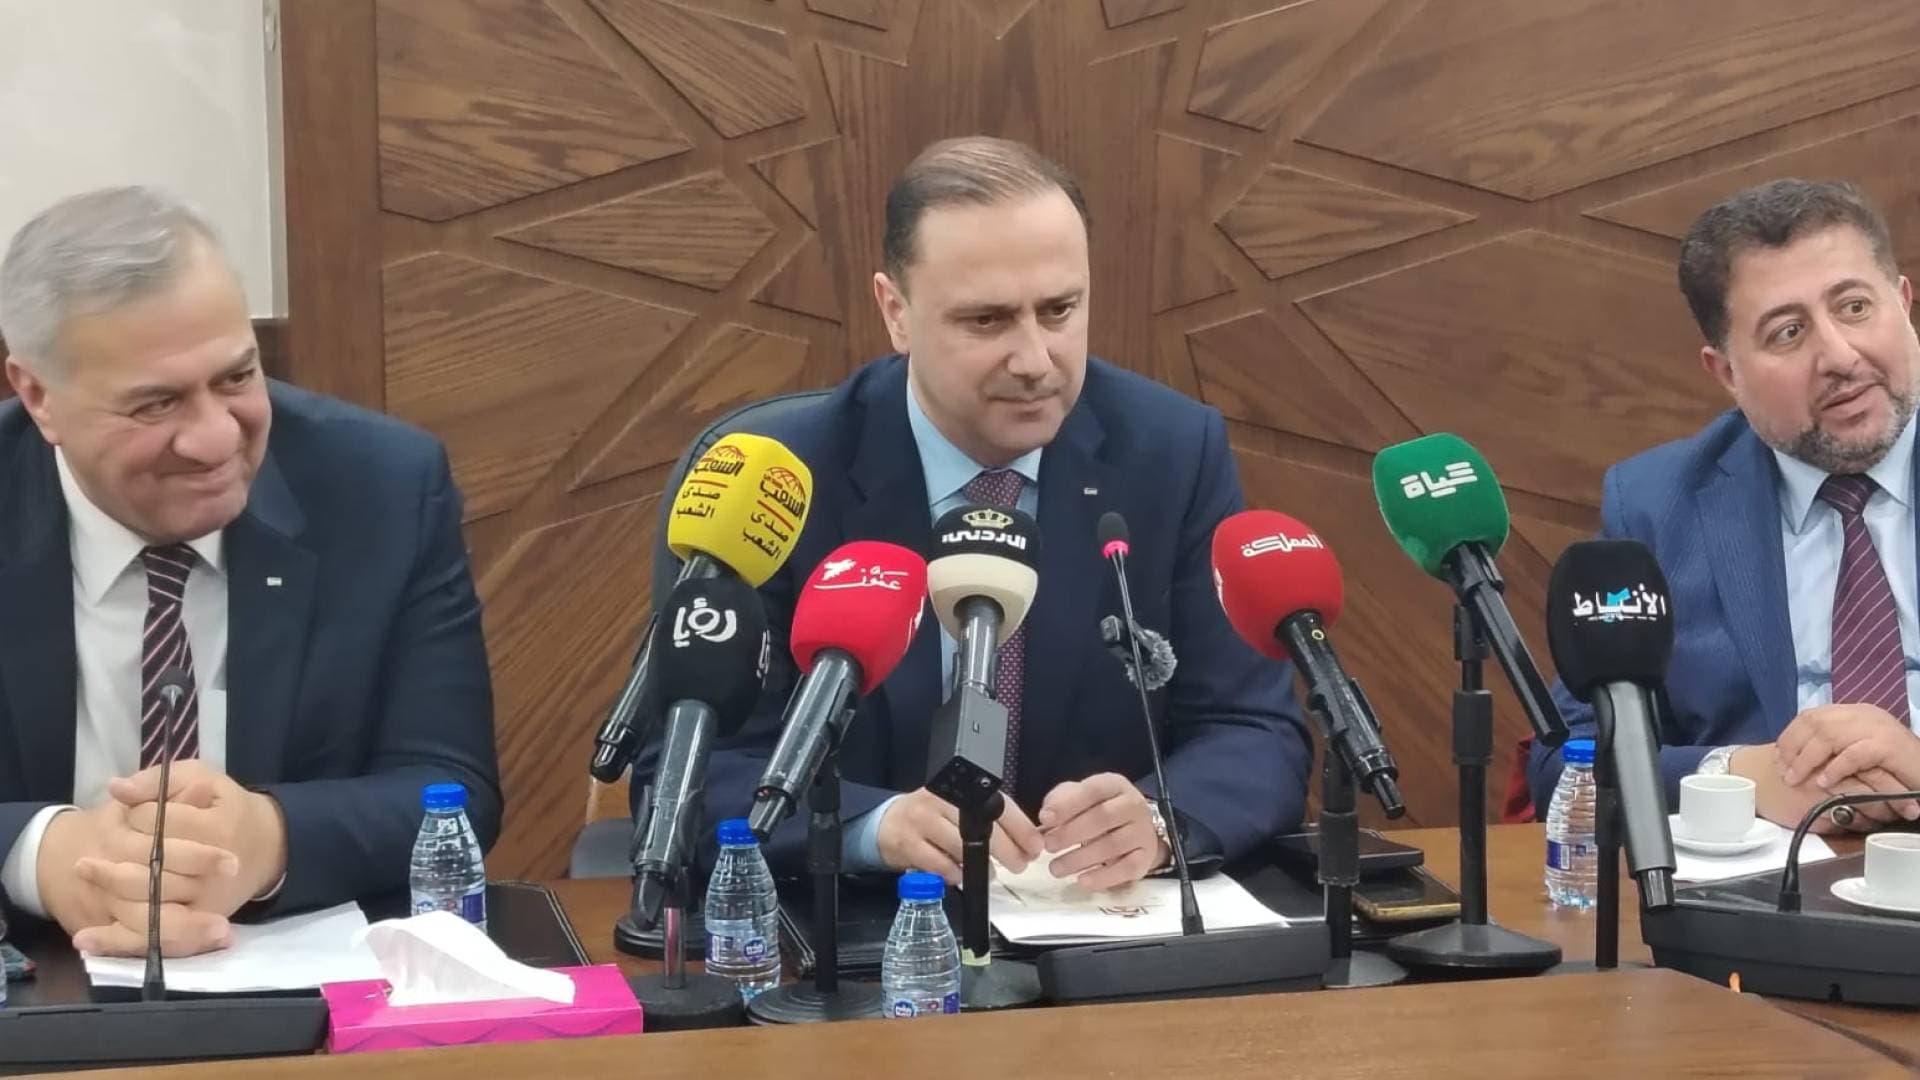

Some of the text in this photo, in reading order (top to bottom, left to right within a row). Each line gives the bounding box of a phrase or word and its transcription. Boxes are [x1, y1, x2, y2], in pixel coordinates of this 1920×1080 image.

[682, 486, 721, 500] صدى
[1400, 461, 1478, 499] حياة
[676, 502, 716, 520] الشعب
[750, 511, 789, 543] صدى
[742, 527, 782, 560] الشعب
[1241, 532, 1324, 557] المملكة
[673, 597, 737, 648] رؤيا
